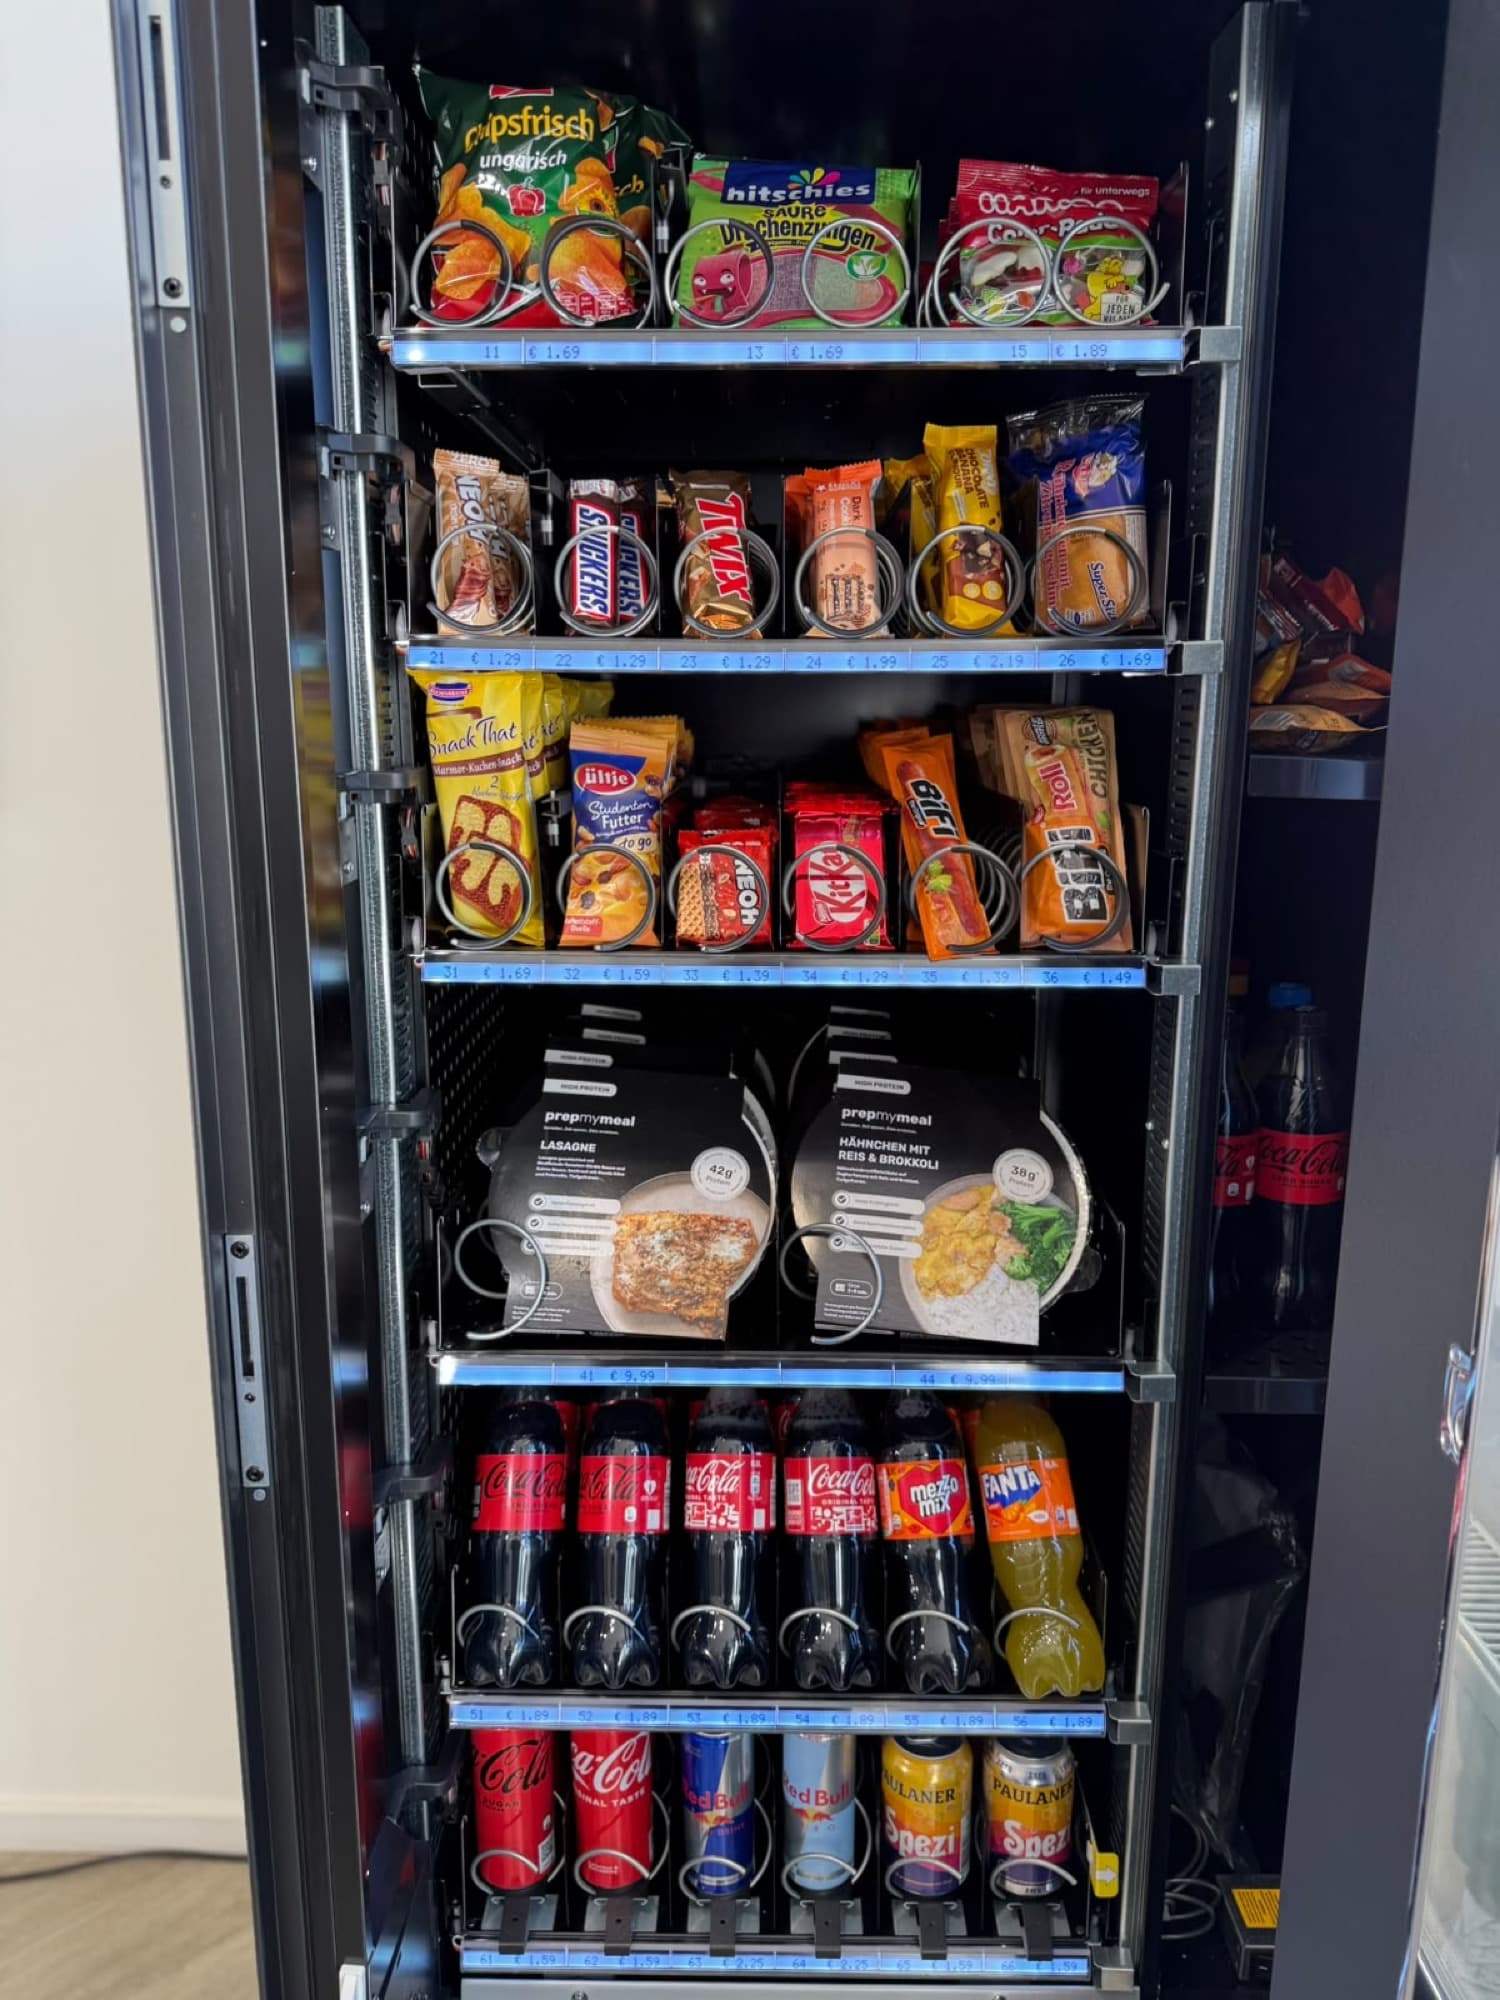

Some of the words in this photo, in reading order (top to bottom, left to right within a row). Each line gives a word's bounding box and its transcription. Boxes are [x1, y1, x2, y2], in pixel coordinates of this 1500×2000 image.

[480, 150, 567, 171] ungarisch
[727, 184, 871, 202] hitschies
[1095, 187, 1150, 197] unterwegs
[485, 345, 500, 359] 11
[529, 346, 537, 359] €
[547, 345, 580, 359] 1.69
[747, 345, 764, 360] 13
[791, 346, 800, 359] €
[810, 346, 843, 359] 1.69
[1011, 345, 1027, 358] 15
[1056, 345, 1064, 358] €
[1074, 344, 1108, 358] 1.89
[851, 496, 862, 521] Dark
[694, 491, 752, 606] TWIX
[1089, 562, 1109, 600] Super
[430, 651, 445, 665] 21
[471, 652, 480, 665] €
[489, 652, 521, 666] 1.29
[556, 653, 573, 667] 22
[597, 655, 605, 667] €
[615, 655, 647, 668] 1.29
[681, 655, 697, 668] 23
[722, 656, 730, 669] €
[739, 655, 771, 669] 1.29
[806, 656, 822, 669] 24
[847, 656, 856, 669] €
[865, 655, 897, 669] 1.99
[932, 655, 949, 669] 25
[974, 655, 981, 668] €
[989, 655, 1024, 668] 2.19
[1059, 653, 1076, 667] 26
[1101, 653, 1109, 666] €
[1119, 652, 1152, 667] 1.69
[476, 716, 517, 746] That
[490, 775, 499, 788] 2
[585, 768, 628, 787] ültje
[1038, 760, 1077, 812] Roll
[588, 800, 653, 821] Studenten
[602, 814, 643, 830] Futter
[620, 836, 634, 850] to
[639, 837, 652, 850] go
[443, 966, 457, 979] 31
[483, 967, 491, 979] €
[500, 967, 531, 980] 1.69
[564, 968, 580, 980] 32
[603, 968, 610, 981] €
[620, 968, 650, 981] 1.59
[683, 969, 699, 981] 33
[722, 969, 730, 981] €
[739, 969, 770, 982] 1.39
[802, 969, 817, 981] 34
[841, 970, 849, 982] €
[858, 970, 889, 983] 1.29
[922, 970, 938, 983] 35
[962, 971, 969, 983] €
[1042, 971, 1059, 984] 36
[1083, 971, 1091, 984] €
[1100, 971, 1132, 984] 1.49
[544, 1111, 636, 1127] prepmymeal
[841, 1108, 932, 1126] prepmymeal
[540, 1140, 597, 1153] LASAGNE
[839, 1135, 907, 1153] HÄHNCHEN
[909, 1144, 931, 1156] MIT
[838, 1150, 866, 1161] REIS
[868, 1153, 877, 1163] &
[879, 1154, 940, 1171] BROKKOLI
[580, 1370, 593, 1382] 41
[610, 1370, 618, 1381] €
[624, 1370, 655, 1382] 9.99
[920, 1374, 935, 1385] 44
[950, 1374, 958, 1385] €
[910, 1474, 959, 1503] mezzo
[981, 1464, 1041, 1499] FANTA
[919, 1491, 951, 1517] mix
[470, 1710, 483, 1721] 51
[506, 1710, 513, 1721] €
[522, 1710, 549, 1721] 1.89
[578, 1710, 592, 1722] 52
[615, 1711, 622, 1722] €
[630, 1710, 657, 1722] 1.89
[687, 1712, 701, 1723] 53
[723, 1712, 730, 1723] €
[738, 1711, 766, 1723] 1.89
[795, 1713, 810, 1724] 54
[832, 1714, 839, 1724] €
[904, 1714, 919, 1725] 55
[940, 1715, 947, 1725] €
[956, 1714, 984, 1726] 1.89
[1013, 1715, 1028, 1727] 56
[1050, 1715, 1057, 1727] €
[1065, 1715, 1093, 1727] 1.89
[612, 1786, 646, 1807] TASTE
[815, 1783, 850, 1807] Bull
[885, 1804, 956, 1858] Spezi
[480, 1955, 493, 1965] 61
[529, 1954, 556, 1965] 1.59
[585, 1956, 599, 1966] 62
[634, 1956, 660, 1967] 1.59
[688, 1957, 702, 1968] 63
[737, 1957, 765, 1968] 2.25
[793, 1958, 806, 1969] 64
[841, 1958, 869, 1969] 2.25
[896, 1960, 911, 1970] 65
[1001, 1960, 1017, 1970] 66
